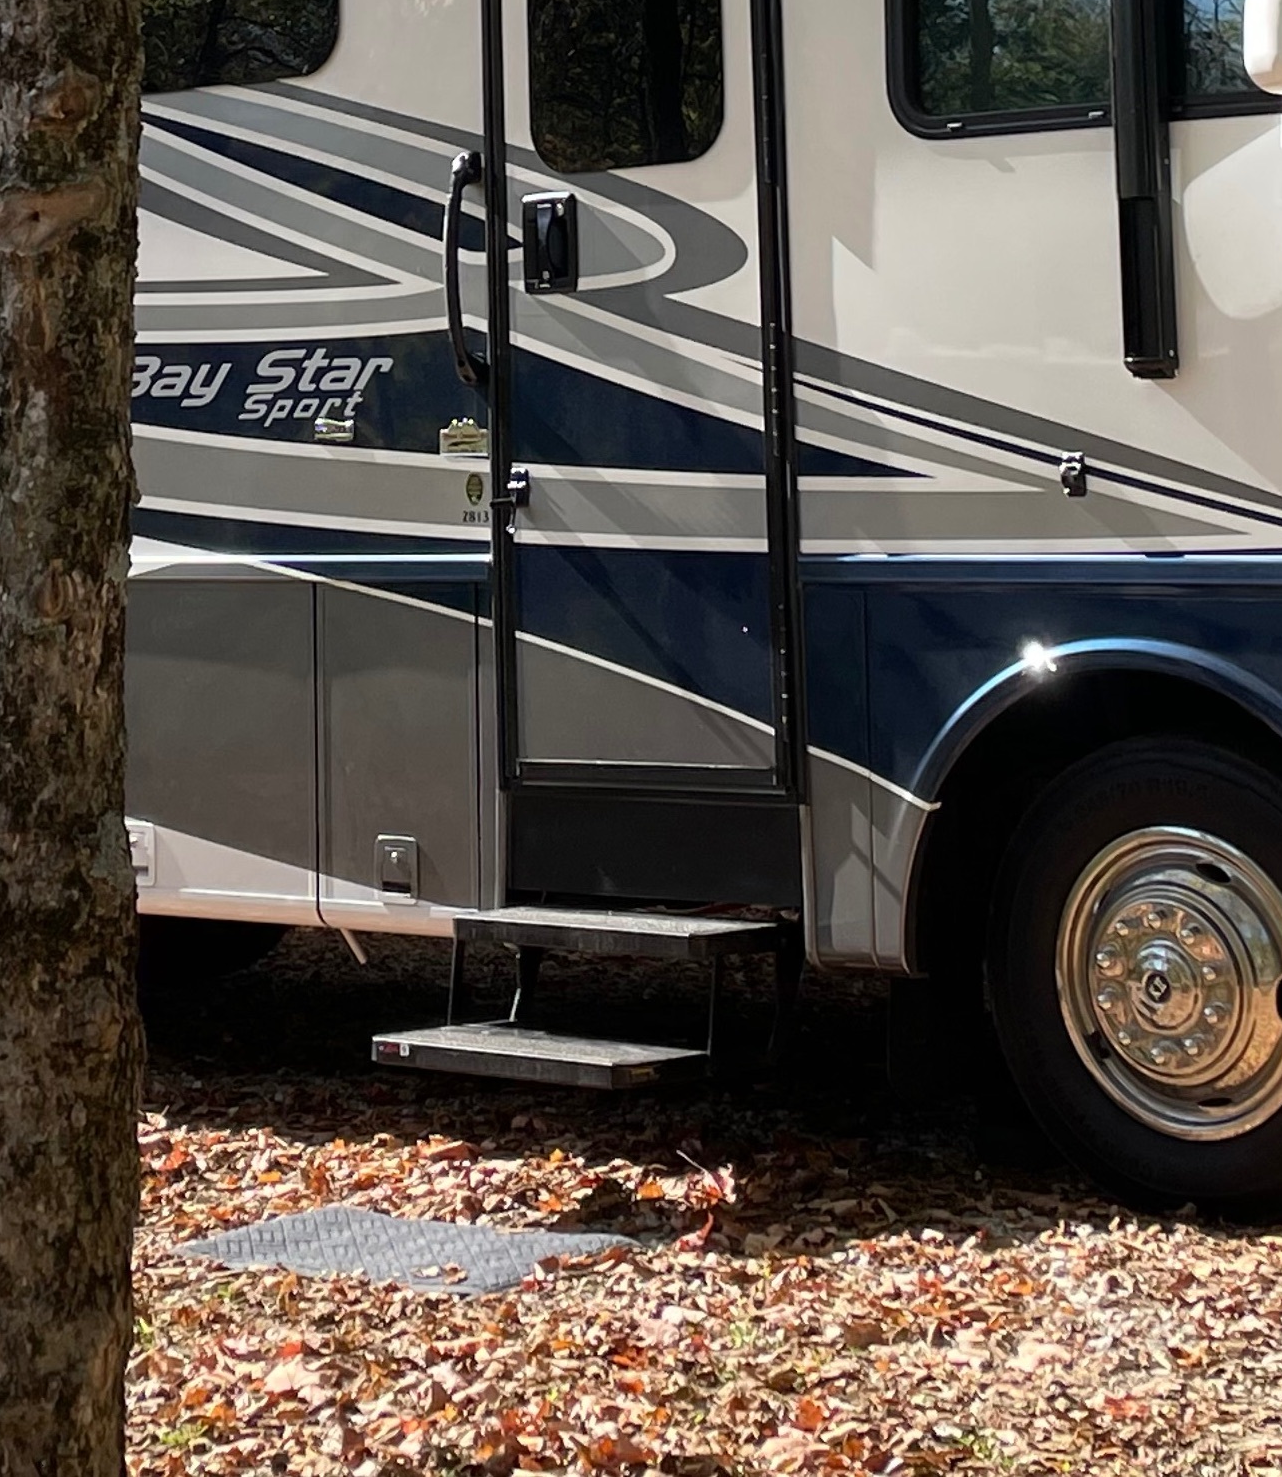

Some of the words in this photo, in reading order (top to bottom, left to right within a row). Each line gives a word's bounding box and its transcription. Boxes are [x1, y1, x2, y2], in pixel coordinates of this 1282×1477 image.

[132, 355, 232, 407] Bay
[245, 348, 394, 394] Star
[238, 390, 363, 427] Sport
